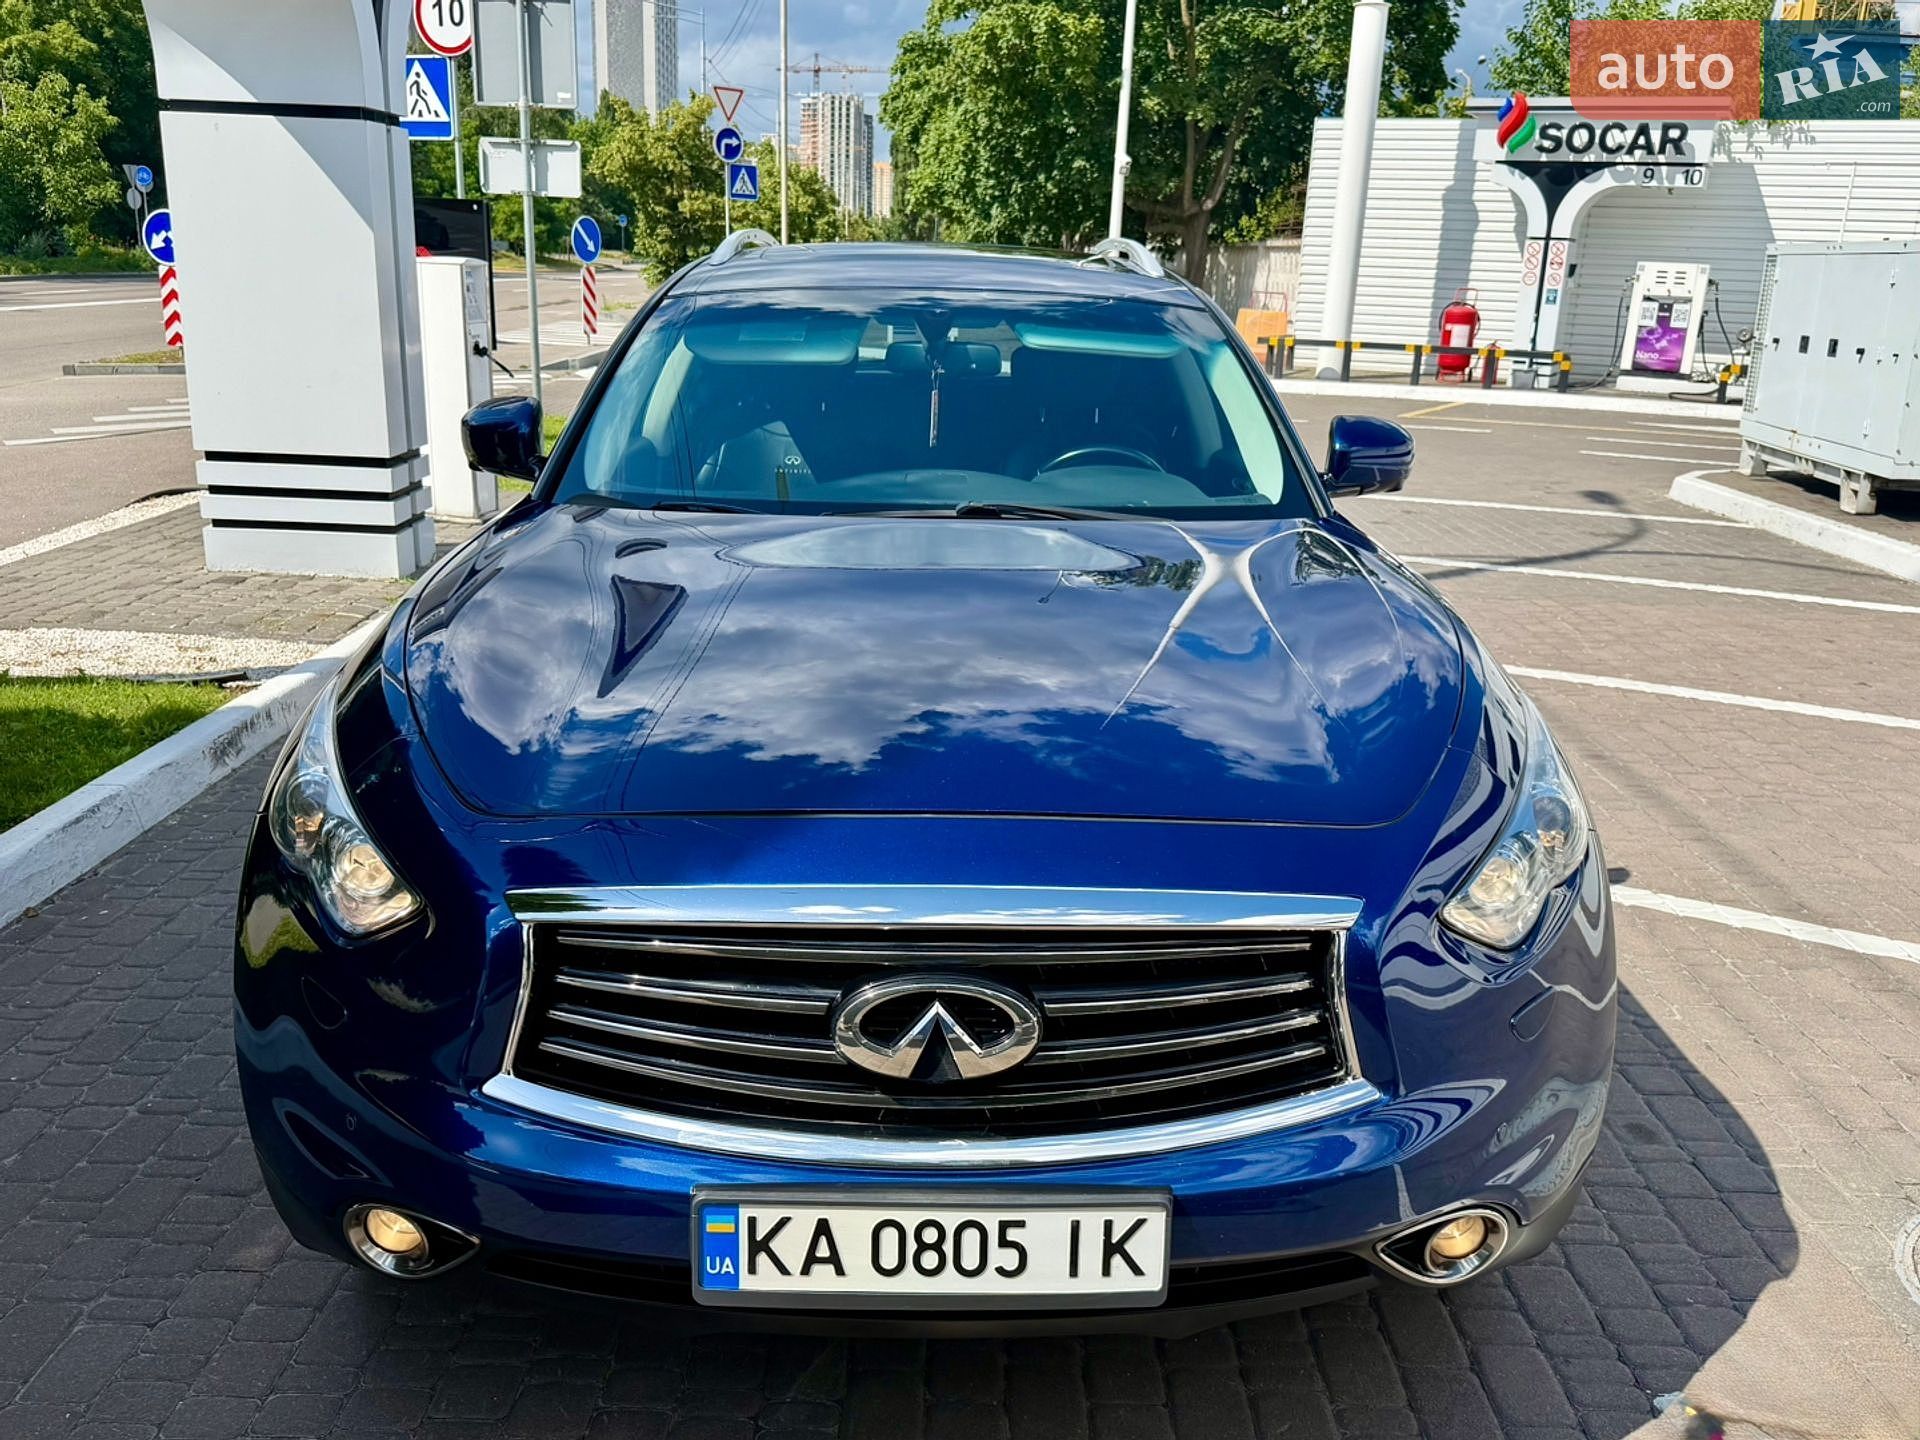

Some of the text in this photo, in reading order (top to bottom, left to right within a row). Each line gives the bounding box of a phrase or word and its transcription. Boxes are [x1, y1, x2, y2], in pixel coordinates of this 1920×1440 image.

[432, 0, 464, 27] 10
[1534, 121, 1689, 156] SOCAR
[1642, 167, 1703, 186] 9 10
[746, 1216, 1149, 1278] KA 0805 IK
[706, 1256, 735, 1275] UA
